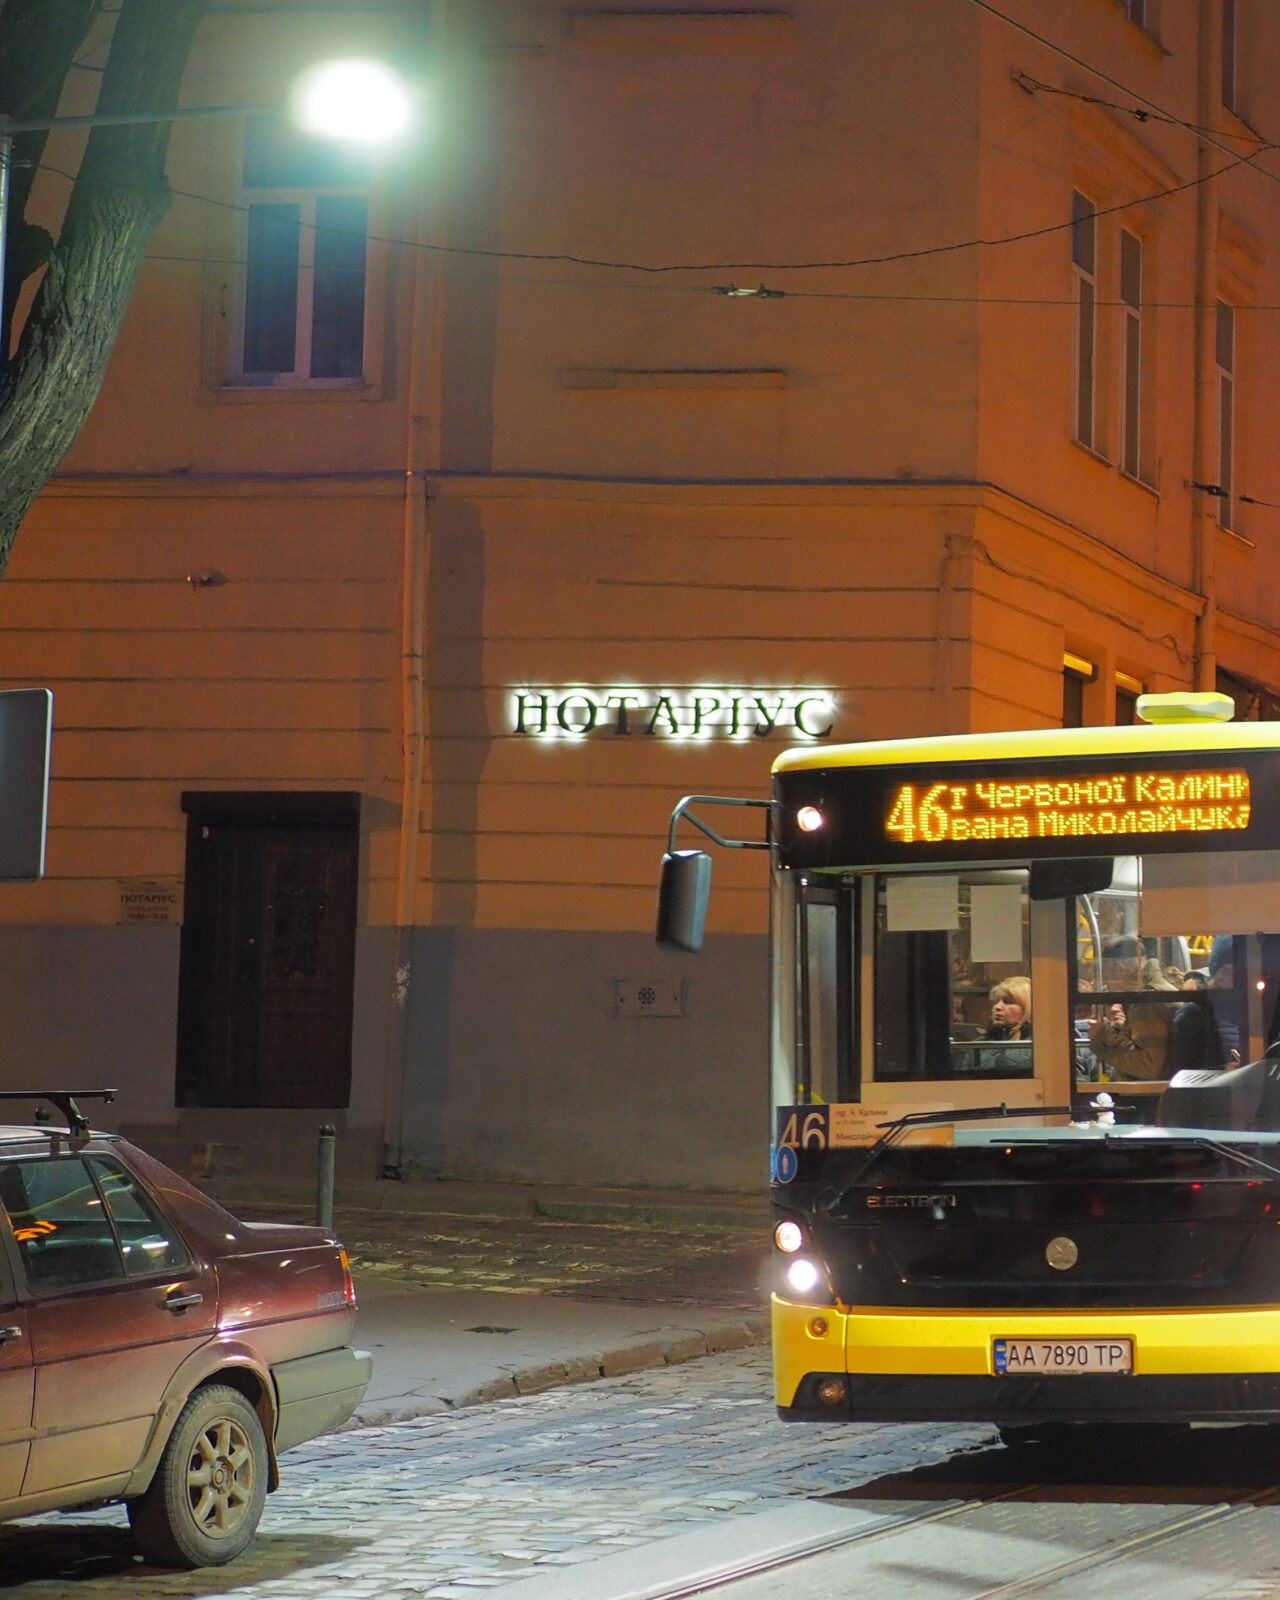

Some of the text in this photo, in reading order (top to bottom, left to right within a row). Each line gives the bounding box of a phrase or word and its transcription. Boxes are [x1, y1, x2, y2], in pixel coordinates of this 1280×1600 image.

[513, 693, 834, 738] НОТАРІУС
[975, 776, 1127, 808] Червоної
[886, 785, 949, 843] 46
[778, 1112, 827, 1151] 46
[1008, 1345, 1124, 1366] AA 7890 TP
